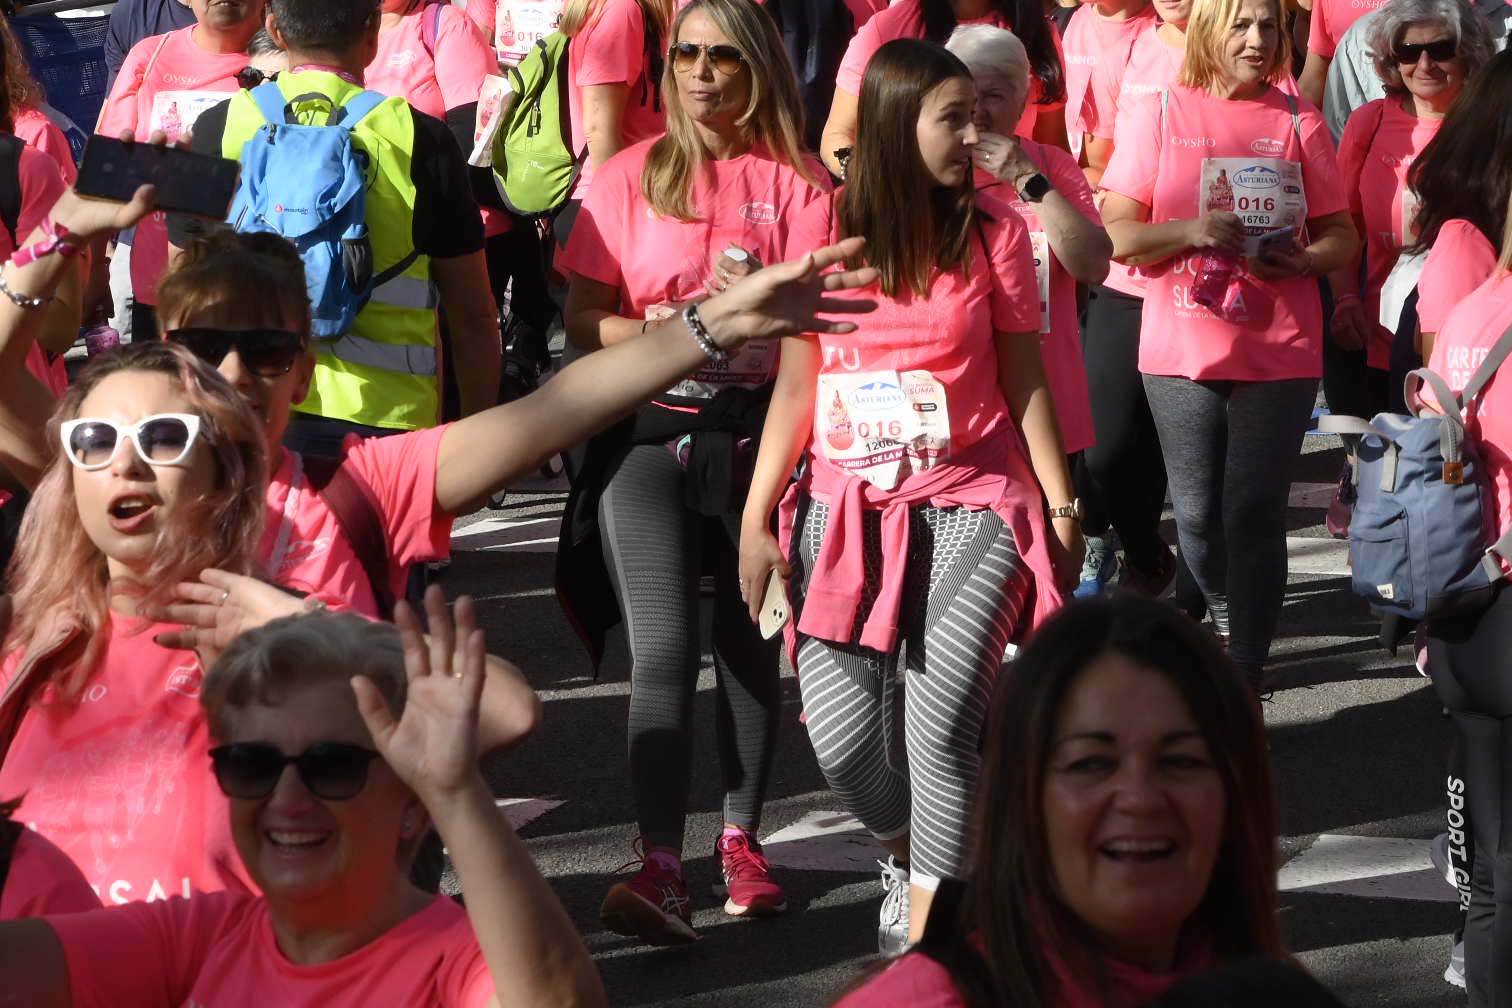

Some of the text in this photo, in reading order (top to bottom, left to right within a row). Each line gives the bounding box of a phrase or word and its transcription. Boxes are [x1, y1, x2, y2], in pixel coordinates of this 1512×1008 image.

[1170, 136, 1216, 148] OYSHO
[1235, 173, 1279, 185] ASTURIANA
[1238, 196, 1275, 212] 016
[1173, 285, 1247, 312] SUA
[825, 345, 861, 370] TU
[857, 419, 902, 438] 016
[1446, 775, 1468, 863] SPORT
